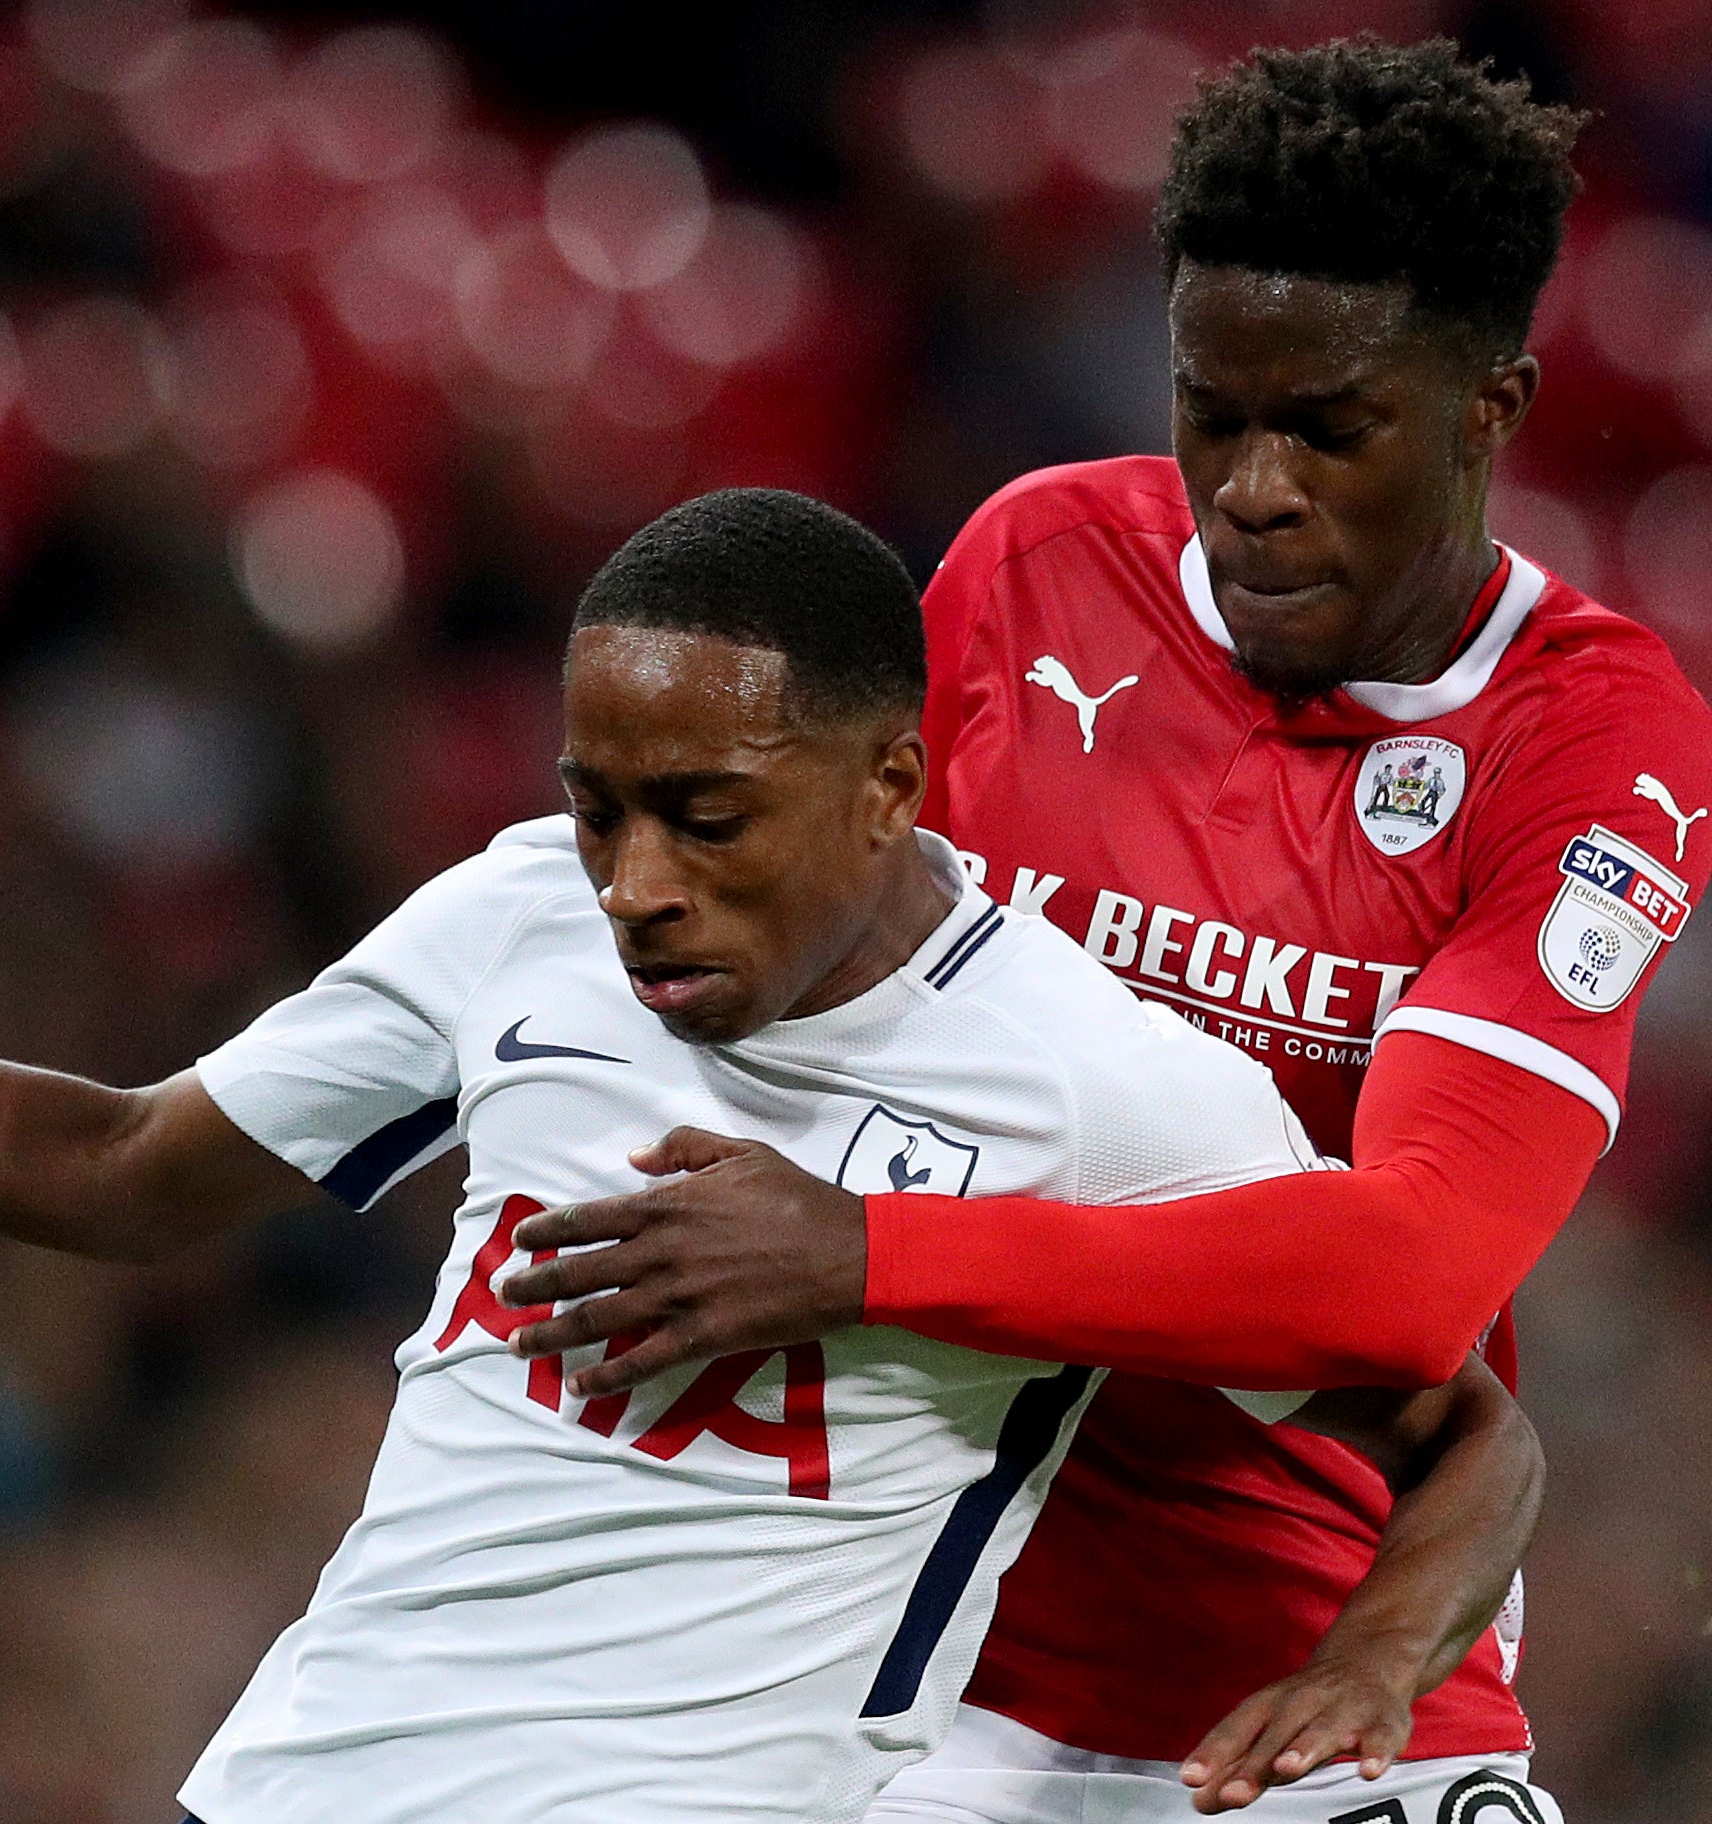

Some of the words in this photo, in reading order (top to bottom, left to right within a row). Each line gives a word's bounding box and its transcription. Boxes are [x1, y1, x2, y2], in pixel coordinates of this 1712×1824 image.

[1376, 739, 1443, 754] BARNSLEY
[1442, 745, 1459, 759] FC
[1381, 833, 1408, 846] 1887
[1573, 884, 1655, 942] CHAMPIONSHIP
[1631, 879, 1679, 926] BET
[1568, 963, 1601, 996] EFL
[1218, 1021, 1271, 1051] THE
